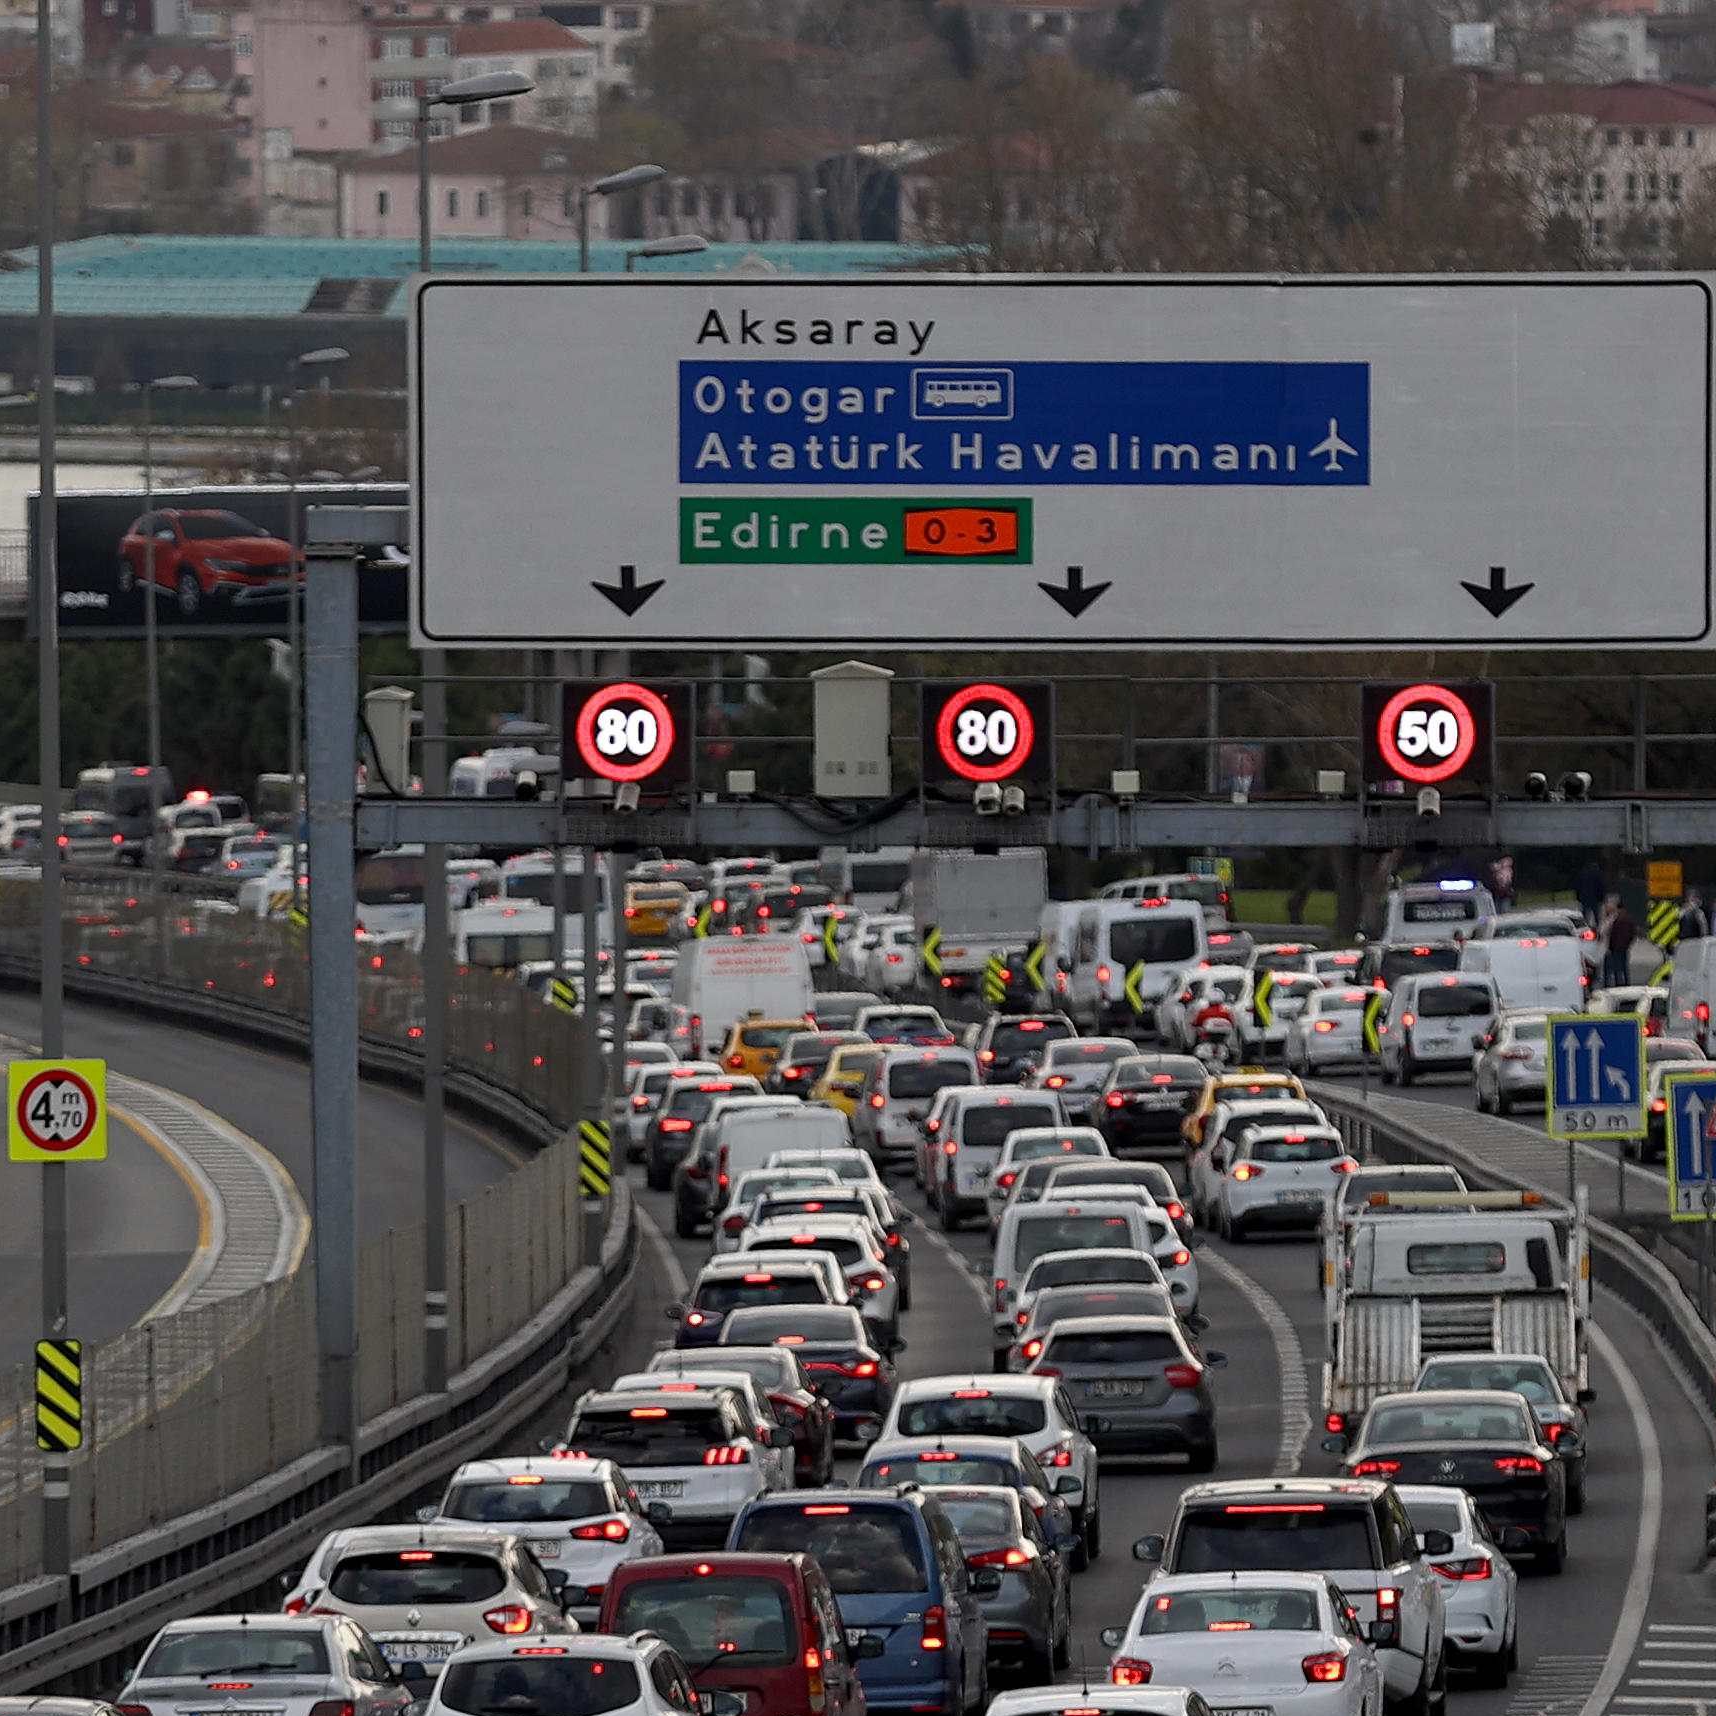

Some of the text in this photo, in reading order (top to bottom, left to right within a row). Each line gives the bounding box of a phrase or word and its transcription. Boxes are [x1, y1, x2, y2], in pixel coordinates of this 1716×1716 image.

[697, 307, 936, 355] Aksaray
[694, 375, 895, 424] Otogar
[695, 432, 1296, 470] Atatürk Havalimanı
[694, 511, 888, 549] Edirne
[596, 708, 658, 757] 80
[957, 709, 1017, 758] 80
[1397, 709, 1459, 758] 50
[61, 1092, 81, 1105] m
[1563, 1110, 1629, 1132] 50 m
